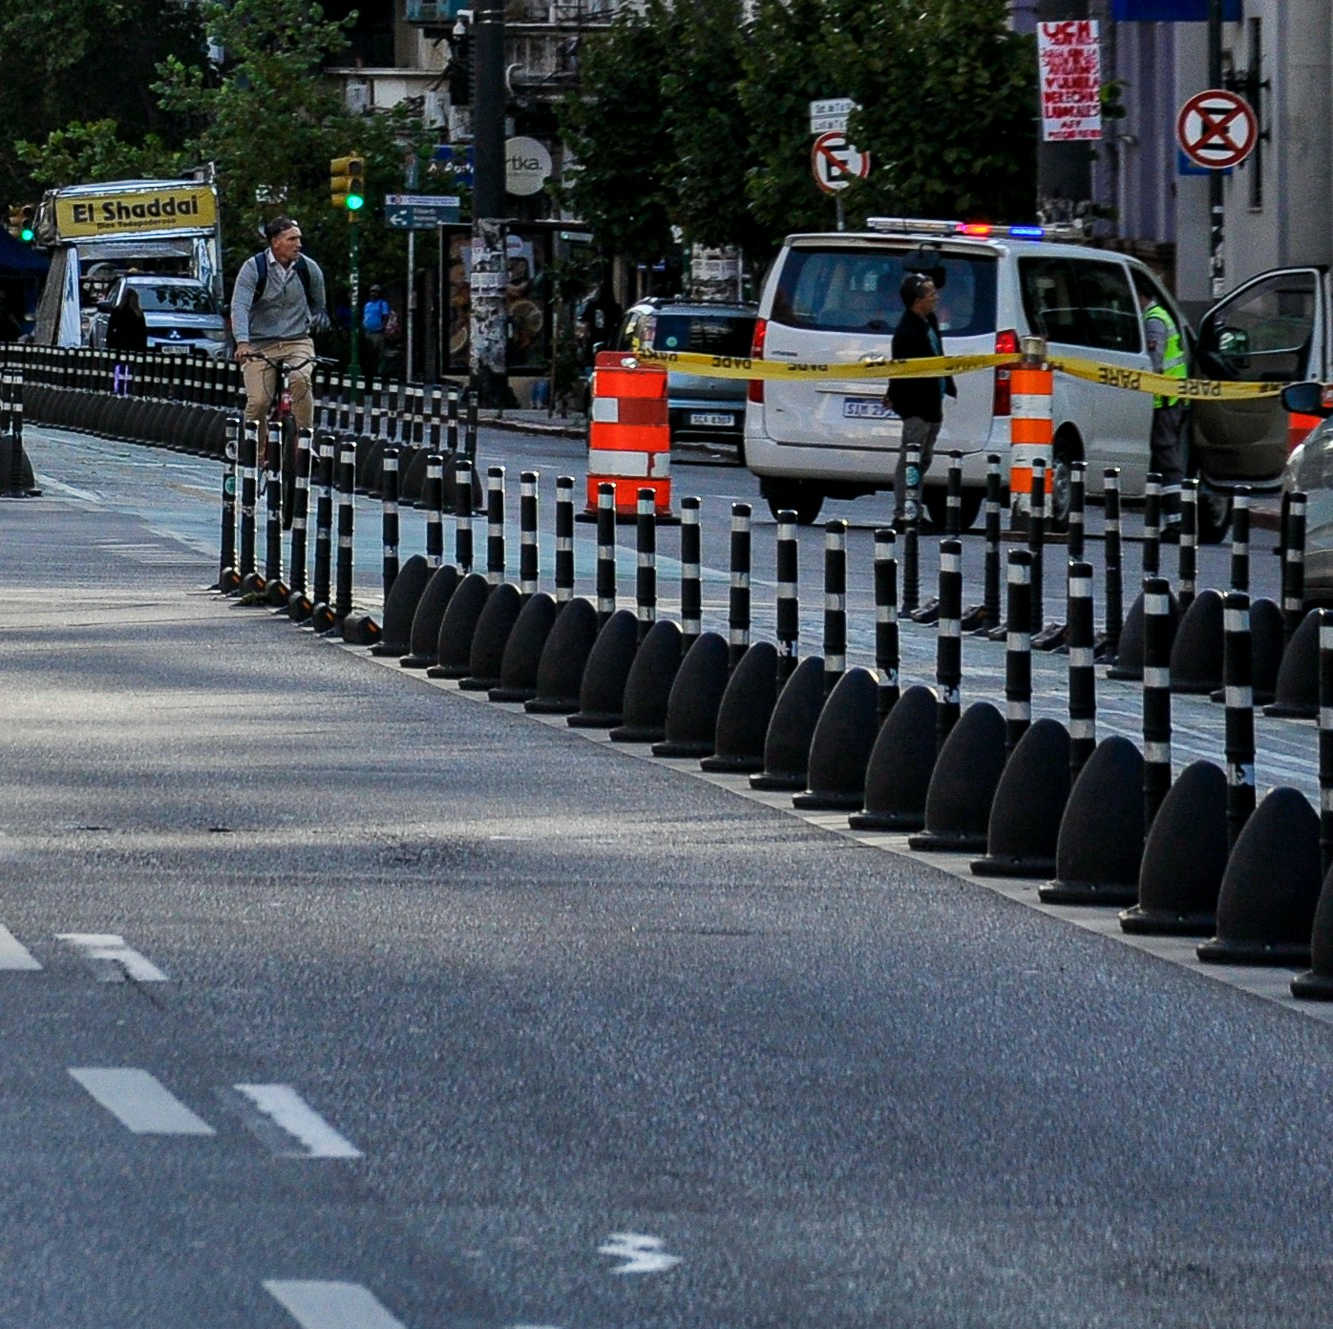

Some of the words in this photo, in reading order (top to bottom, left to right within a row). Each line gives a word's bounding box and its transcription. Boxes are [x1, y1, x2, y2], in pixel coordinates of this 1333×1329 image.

[73, 204, 94, 222] El
[102, 195, 198, 221] Shaddai
[1098, 367, 1141, 390] PARE
[1178, 378, 1221, 396] PARE
